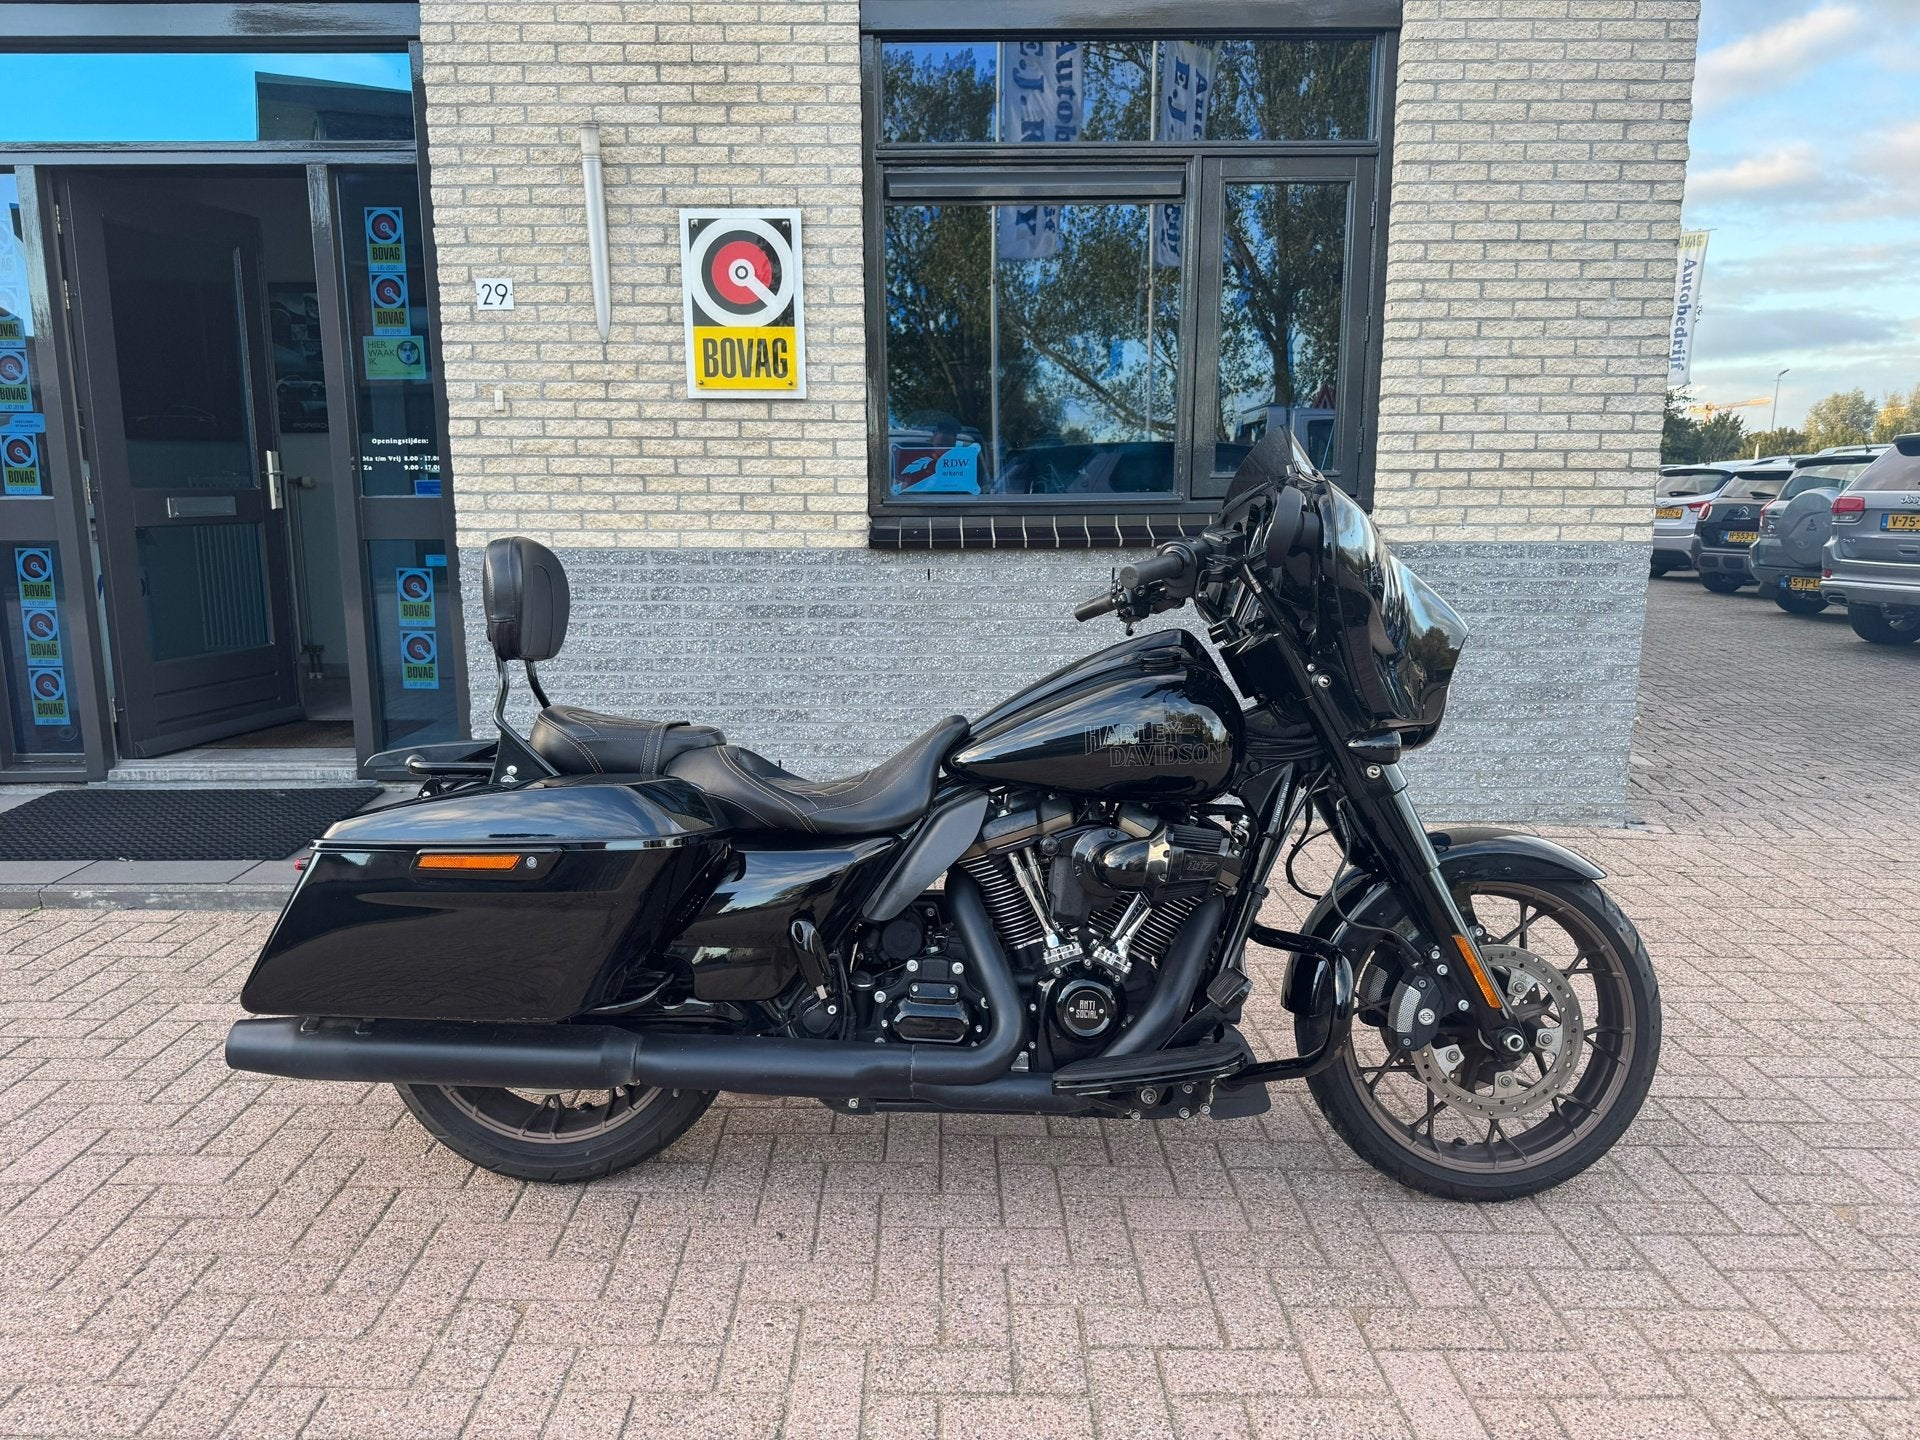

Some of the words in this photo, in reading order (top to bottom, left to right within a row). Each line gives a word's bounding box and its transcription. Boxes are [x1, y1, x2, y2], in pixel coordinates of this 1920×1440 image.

[372, 247, 400, 260] BOVAG
[481, 283, 508, 305] 29
[377, 311, 404, 325] BOVAG
[1670, 257, 1698, 371] Autobedrijf
[0, 323, 20, 336] VAG
[367, 341, 386, 349] HIER
[367, 349, 396, 357] WAAK
[703, 337, 788, 379] BOVAG
[368, 358, 377, 366] IK
[0, 387, 27, 400] BOVAG
[371, 437, 429, 445] Openingstijden:
[387, 455, 402, 463] Vrij
[943, 458, 969, 468] RDW
[8, 470, 35, 483] BOVAG
[1901, 494, 1920, 506] Jee
[24, 584, 50, 597] BOVAG
[403, 604, 430, 617] BOVAG
[31, 643, 57, 656] BOVAG
[407, 666, 434, 679] BOVAG
[38, 703, 64, 715] BOVAG
[1109, 742, 1223, 768] DAVIDSON
[1079, 999, 1096, 1010] ANTI
[1075, 1009, 1098, 1019] SOCIAL
